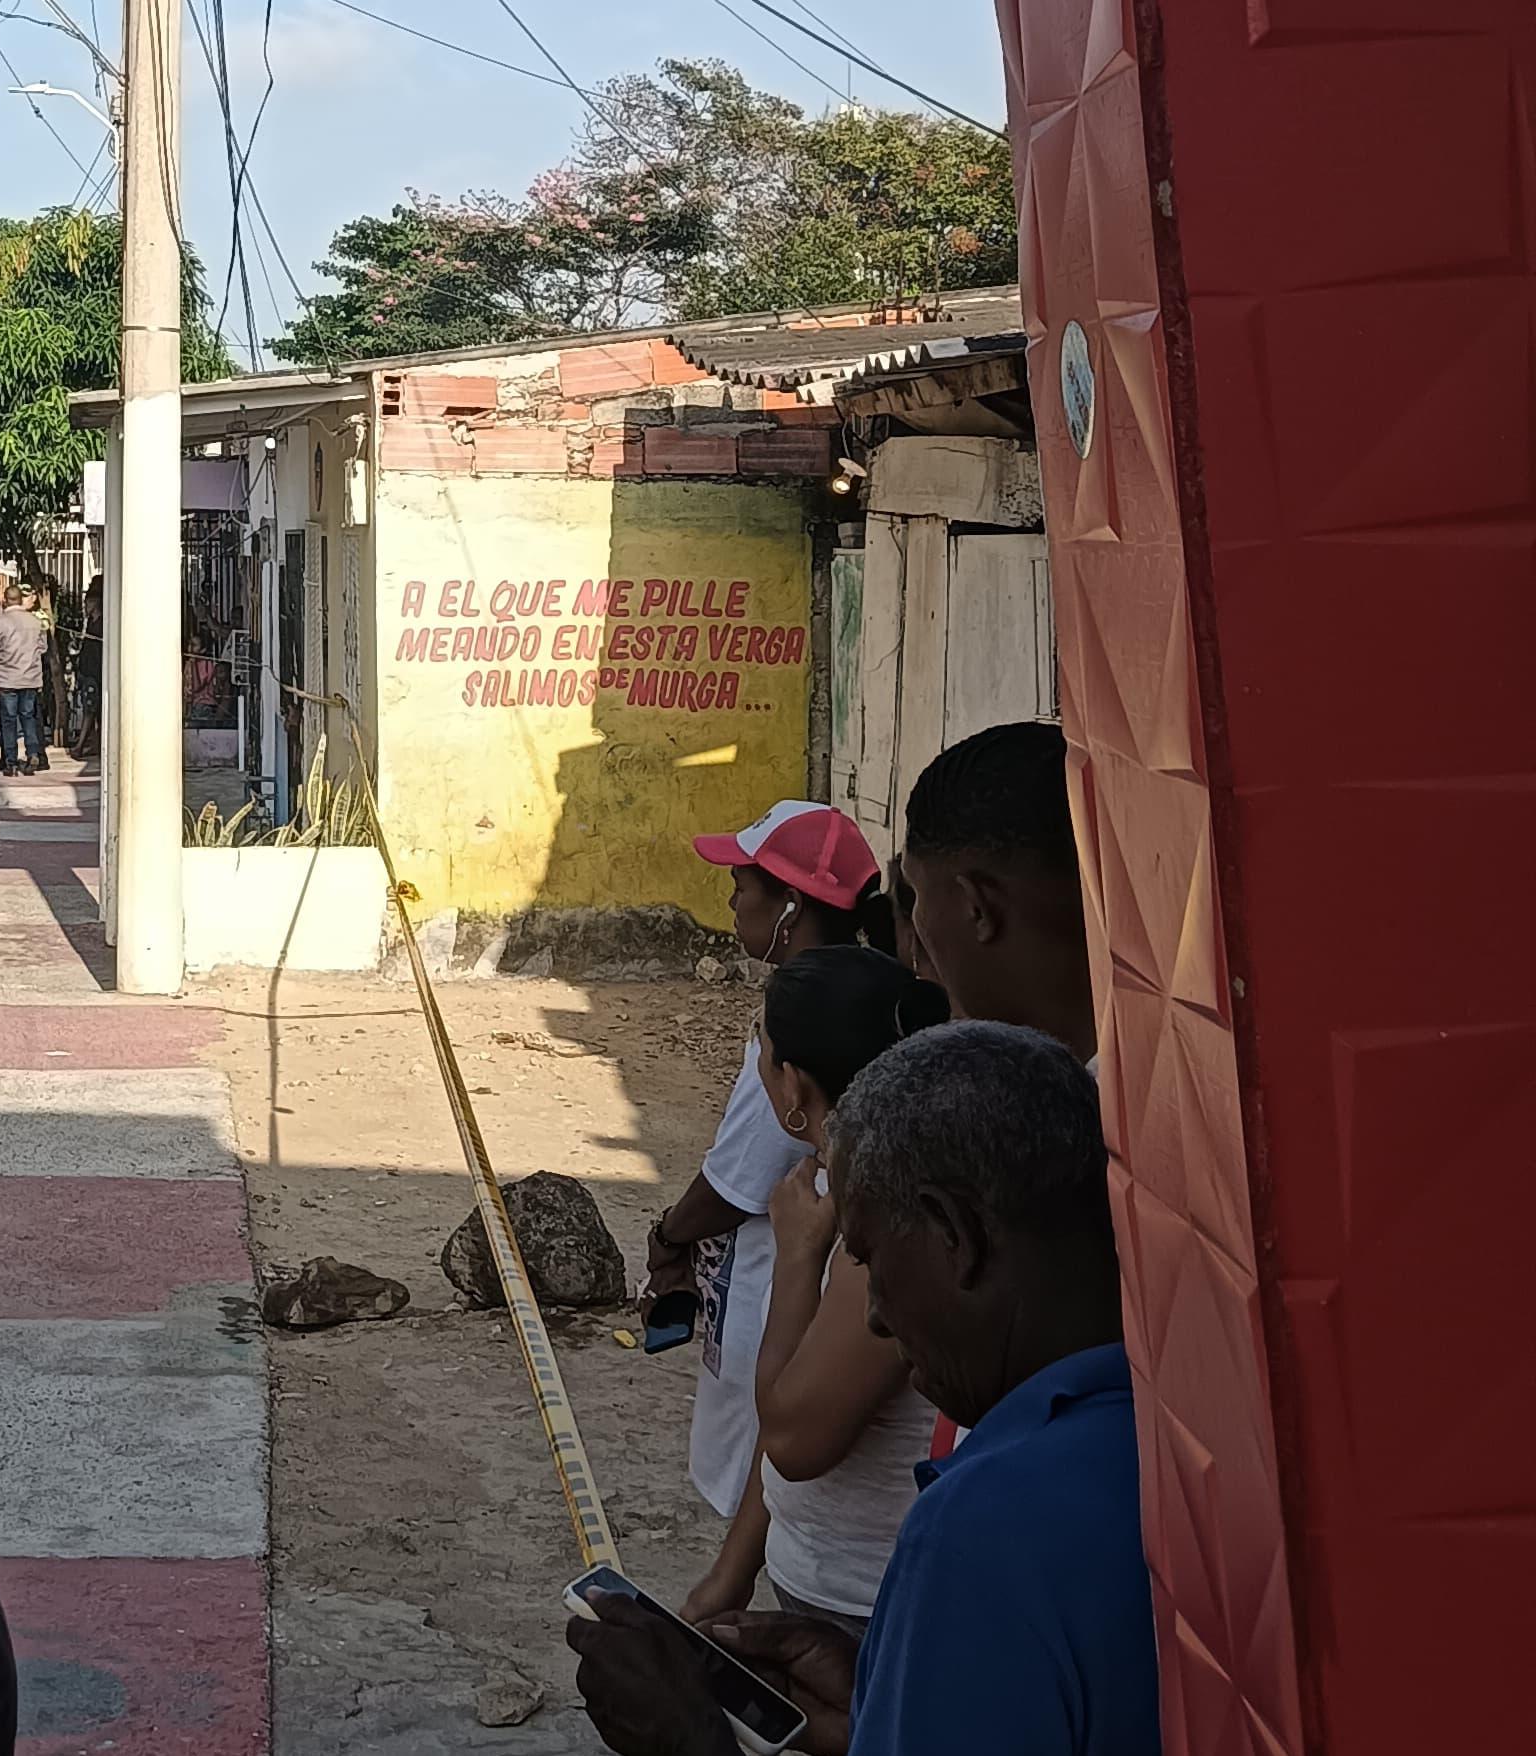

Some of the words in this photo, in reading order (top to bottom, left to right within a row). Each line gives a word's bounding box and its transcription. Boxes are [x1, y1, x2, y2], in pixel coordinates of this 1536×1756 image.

[401, 580, 426, 618] A
[438, 580, 480, 617] EL
[490, 579, 566, 623] QUE
[572, 579, 634, 617] ME
[640, 579, 750, 617] PILLE
[395, 625, 542, 662] MEANDO
[551, 625, 602, 661] EN
[608, 625, 699, 661] ESTA
[709, 623, 805, 665] VERGA
[462, 669, 597, 707] SALIMOS
[599, 667, 630, 689] DE
